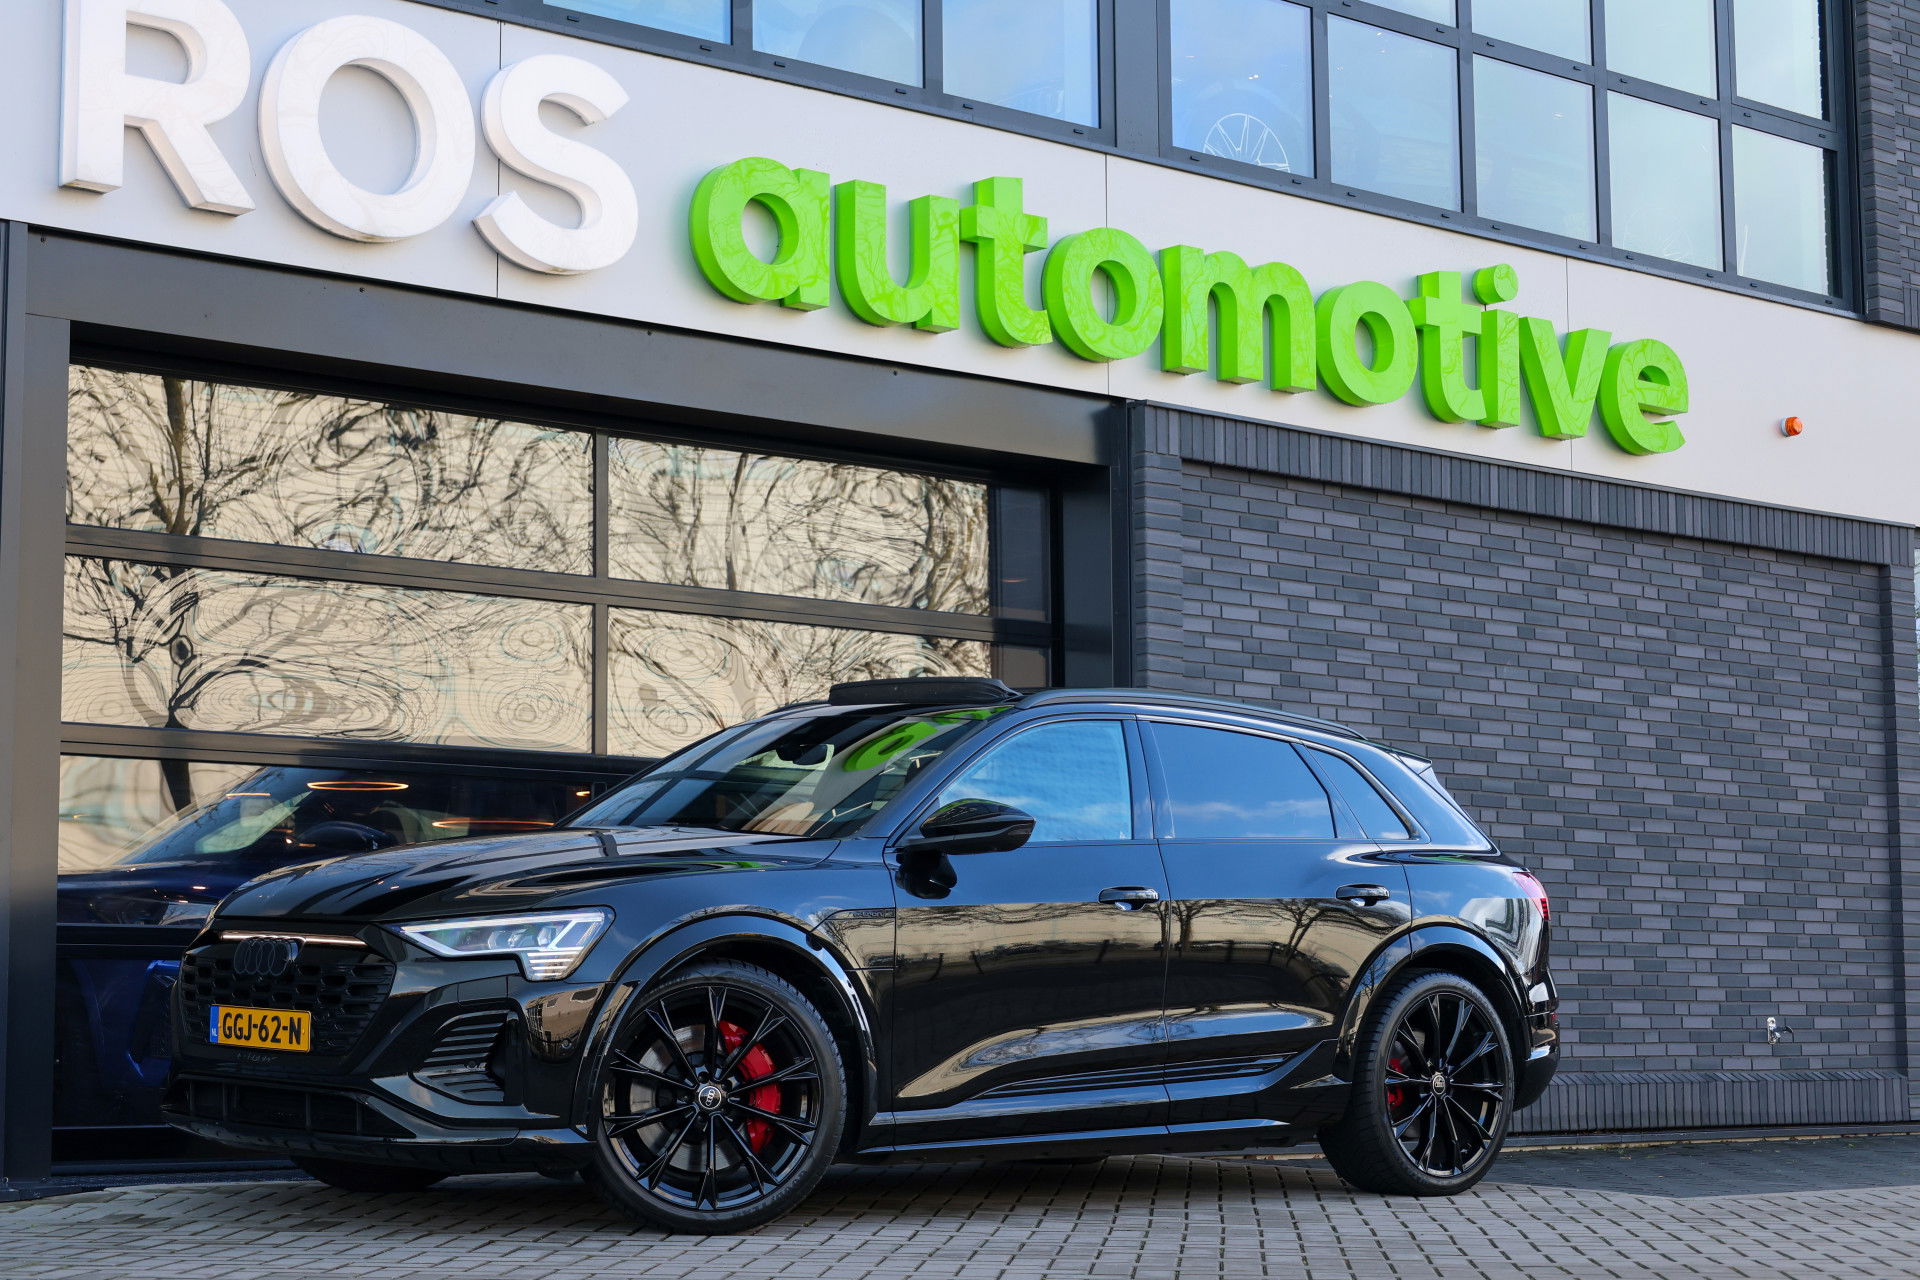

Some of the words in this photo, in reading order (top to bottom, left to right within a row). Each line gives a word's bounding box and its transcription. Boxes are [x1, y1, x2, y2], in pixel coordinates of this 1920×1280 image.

[59, 0, 639, 275] ROS
[688, 157, 1689, 456] automotive
[222, 1012, 302, 1045] GGJ-62-N
